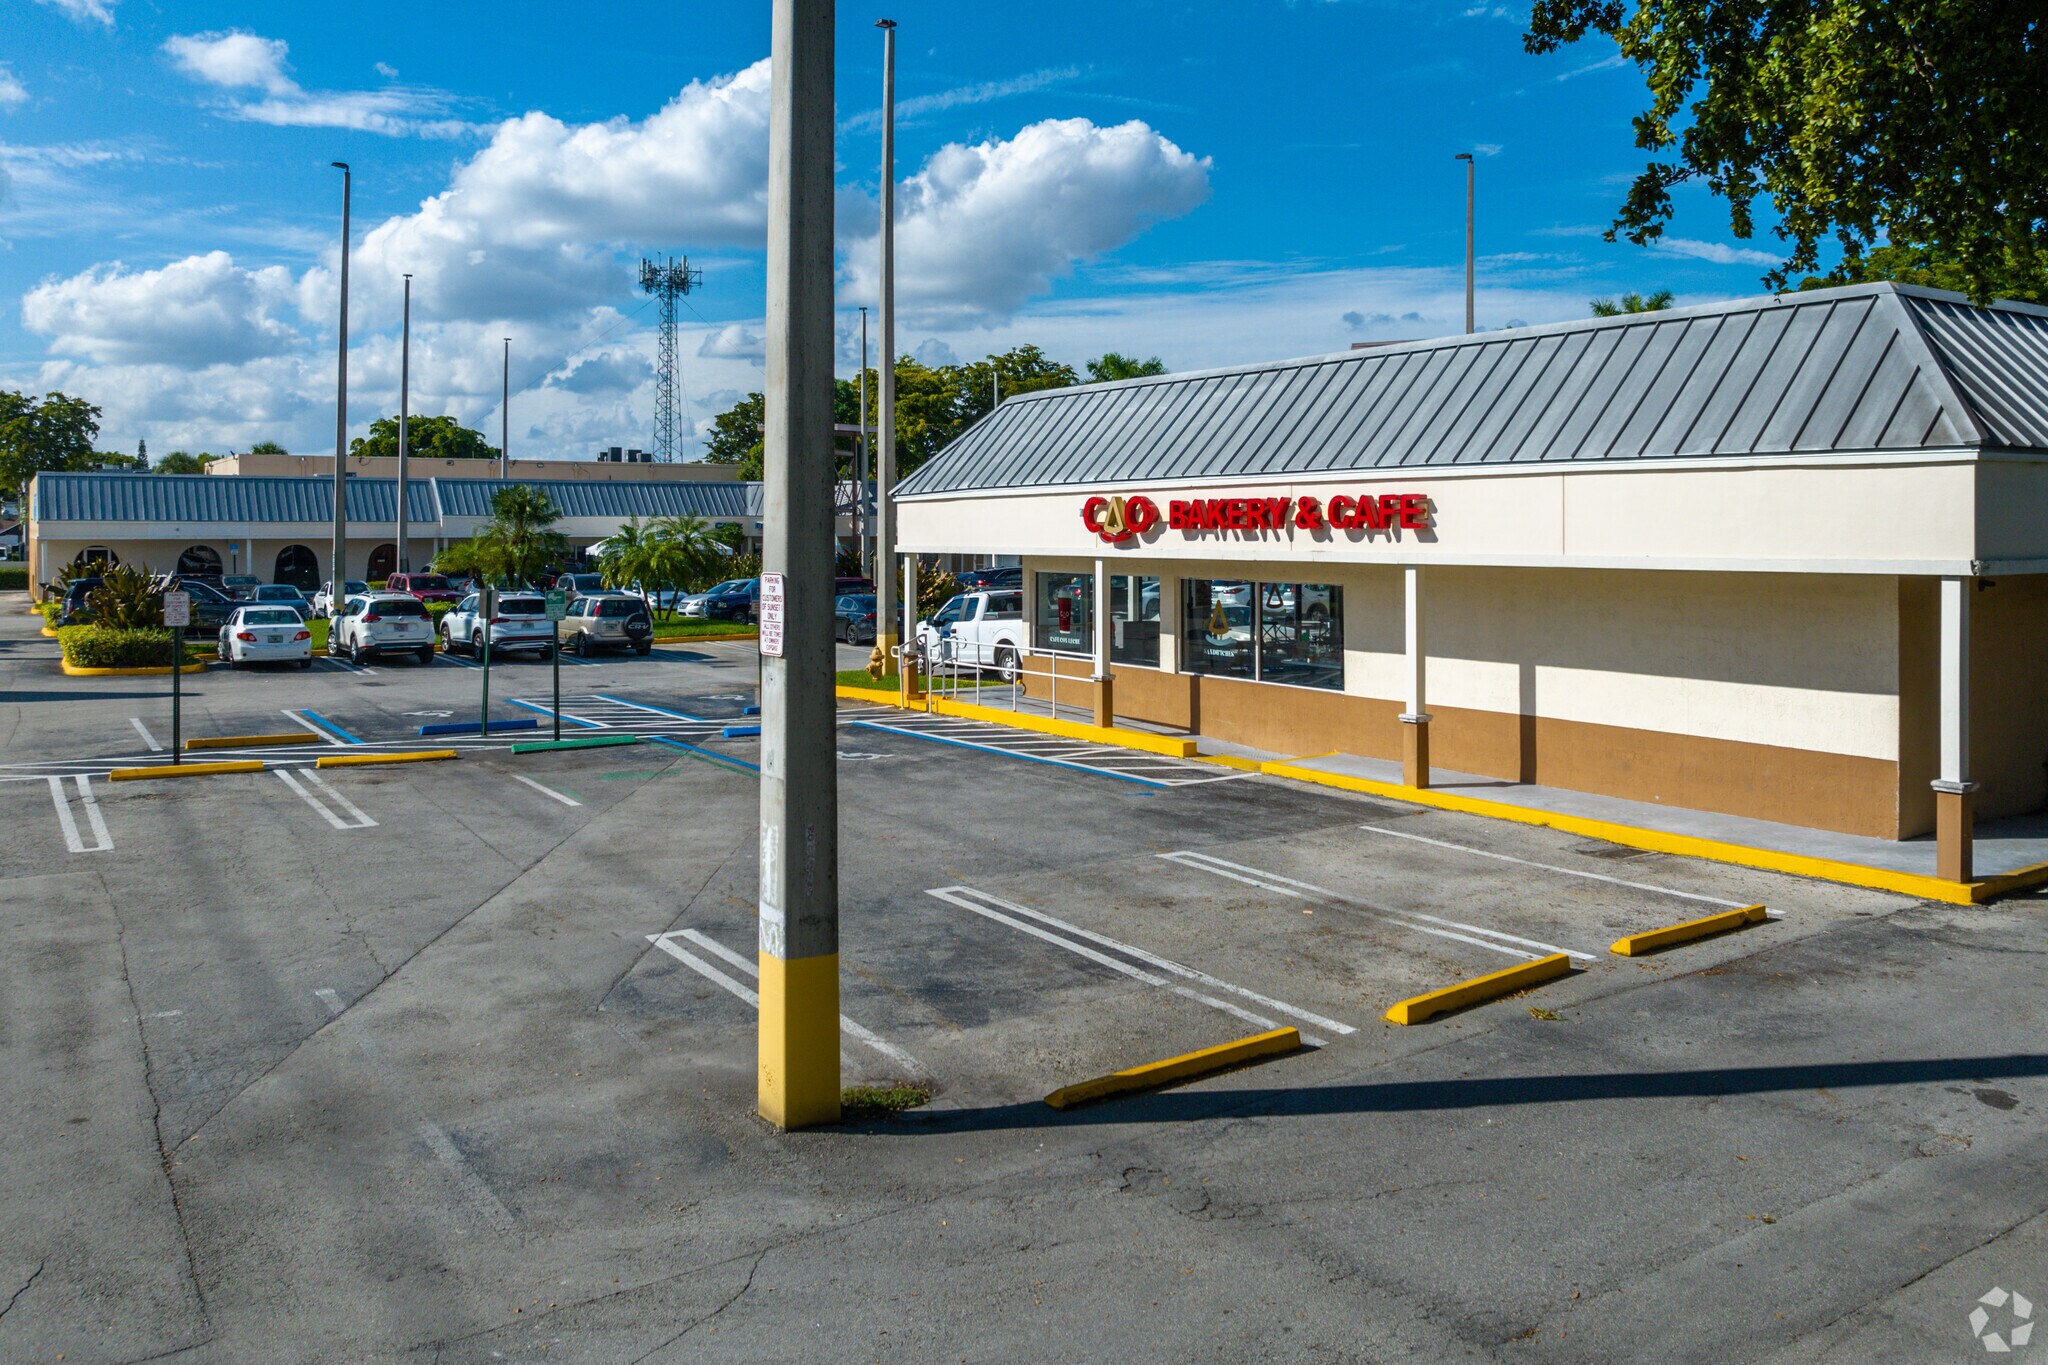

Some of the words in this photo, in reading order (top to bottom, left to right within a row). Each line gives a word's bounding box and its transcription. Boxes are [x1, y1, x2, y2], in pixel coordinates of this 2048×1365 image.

[1169, 497, 1291, 530] BAKERY
[1295, 496, 1324, 530] &
[1328, 494, 1429, 530] CAFE
[764, 576, 780, 584] PARKING
[768, 585, 776, 593] FOR
[762, 594, 783, 603] CUSTOMERS
[767, 603, 781, 612] SUNSET
[767, 612, 777, 621] ONLY
